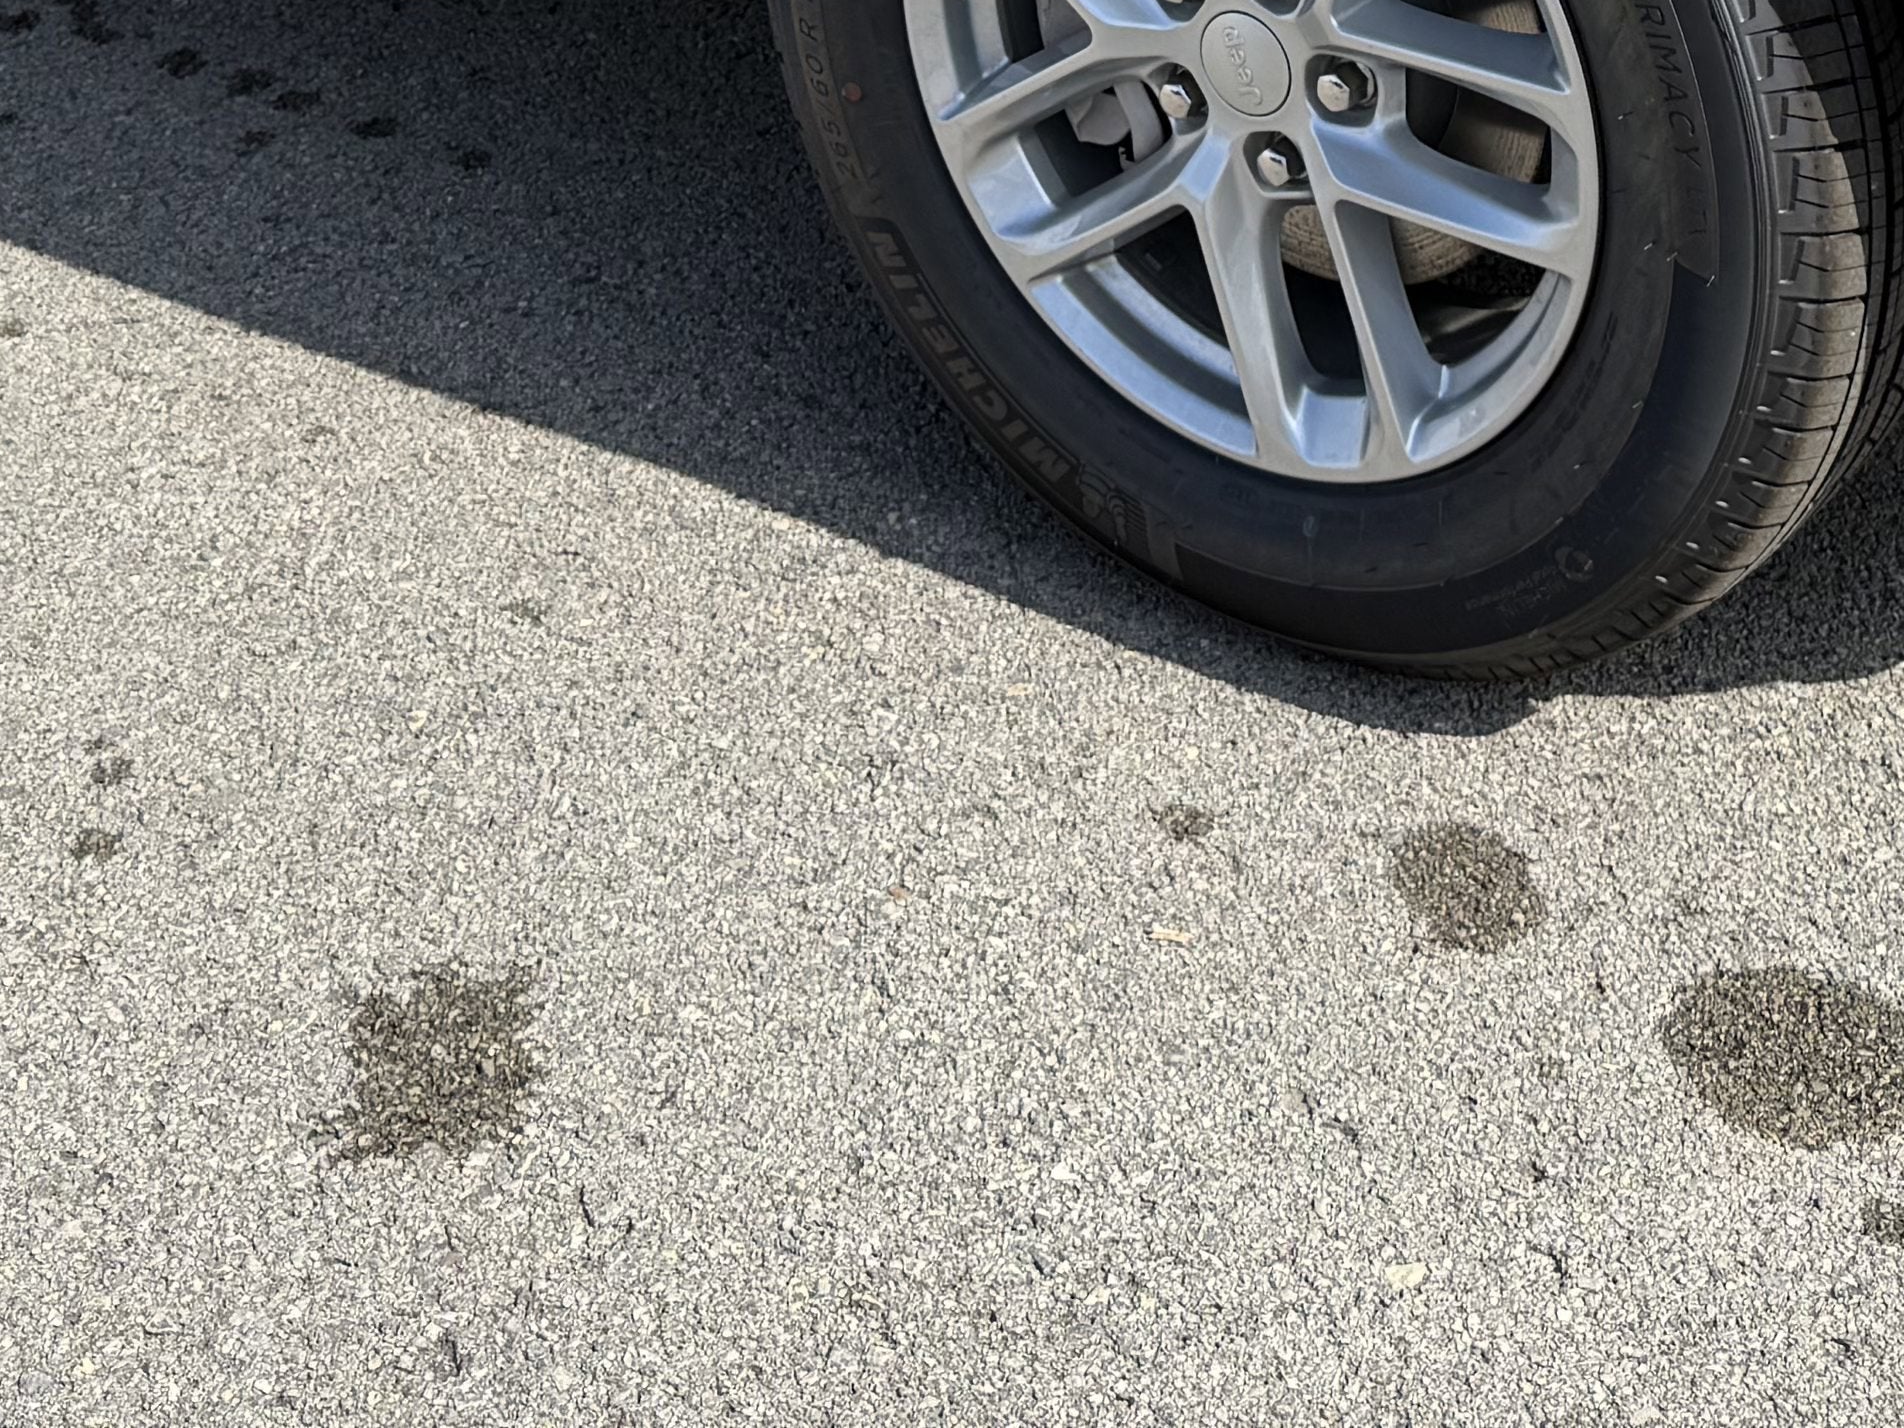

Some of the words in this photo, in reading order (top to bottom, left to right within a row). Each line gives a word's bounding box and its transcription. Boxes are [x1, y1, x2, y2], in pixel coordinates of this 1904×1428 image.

[799, 17, 818, 43] R
[1222, 26, 1264, 107] Jeep
[805, 55, 857, 179] 265/60
[865, 231, 1071, 483] MICHELIN
